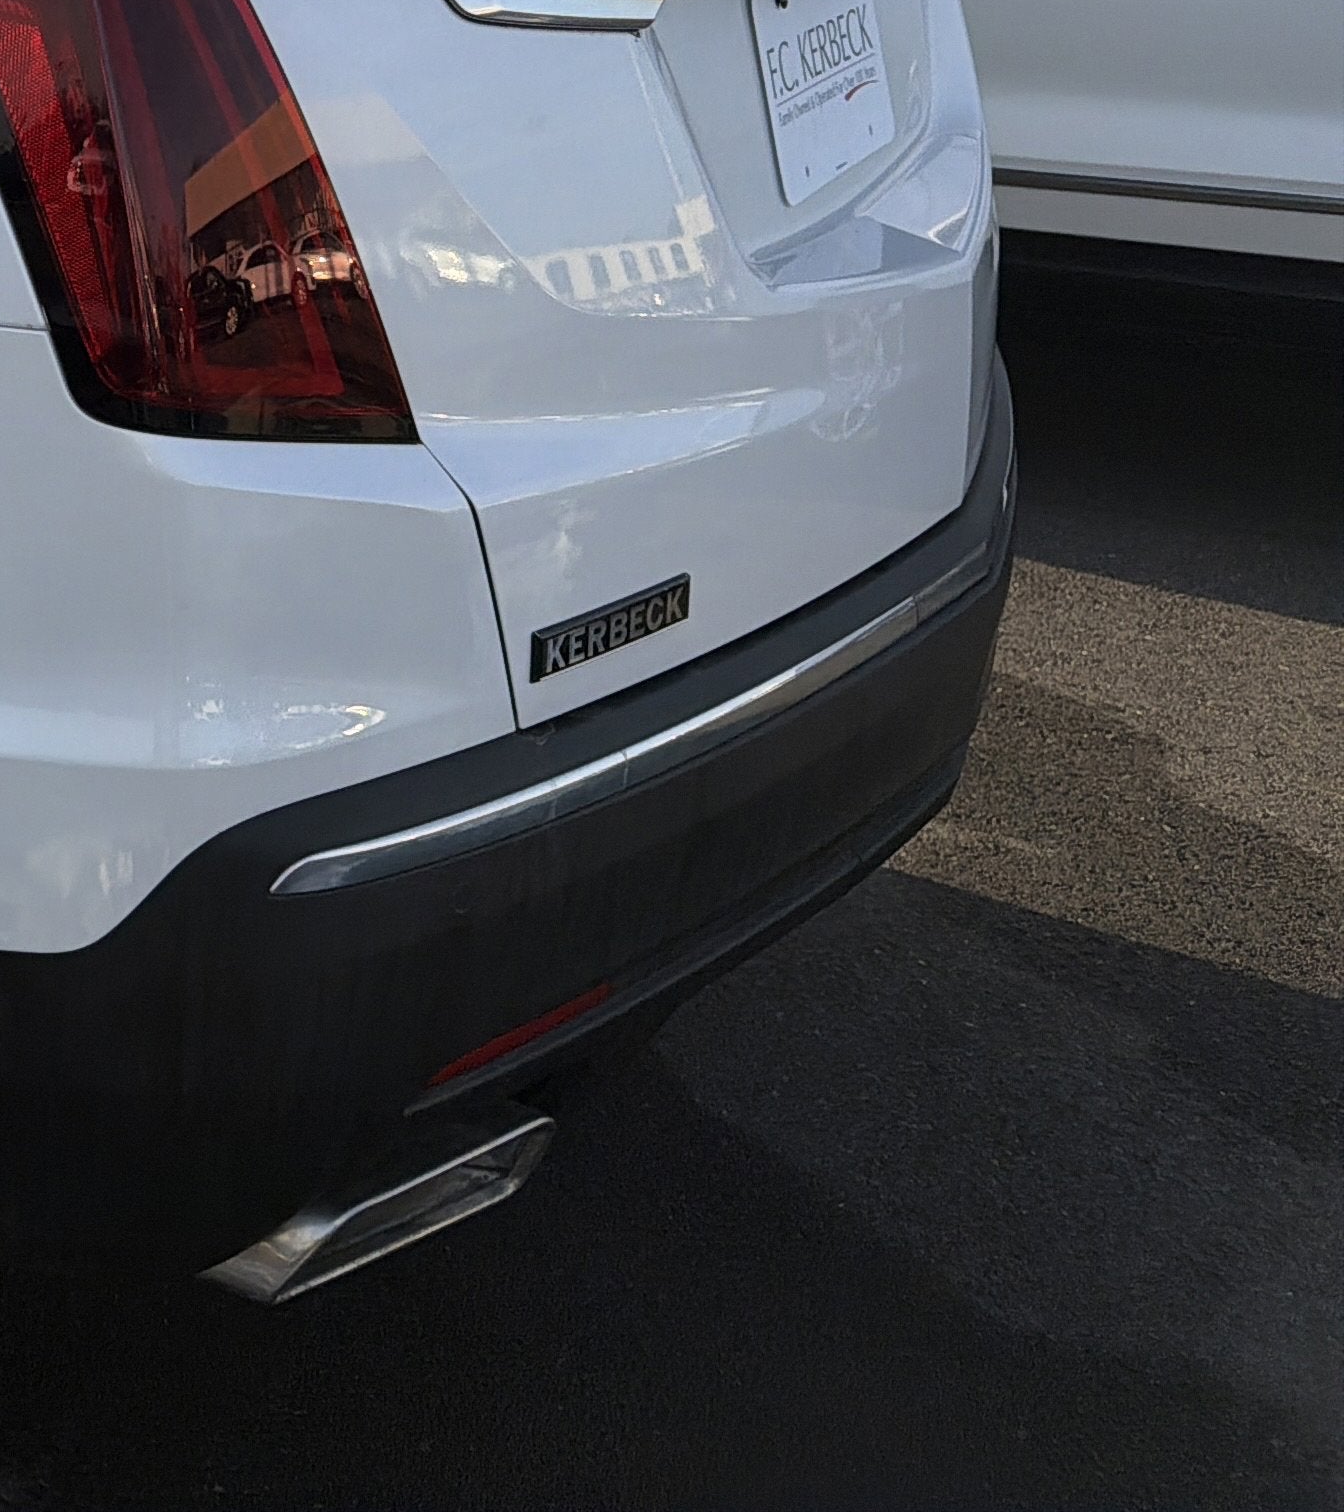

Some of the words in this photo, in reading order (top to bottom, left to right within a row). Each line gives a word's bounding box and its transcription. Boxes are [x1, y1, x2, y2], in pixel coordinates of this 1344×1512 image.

[766, 40, 800, 100] F.C.
[796, 3, 874, 83] KERBECK
[545, 586, 685, 673] KERBECK
